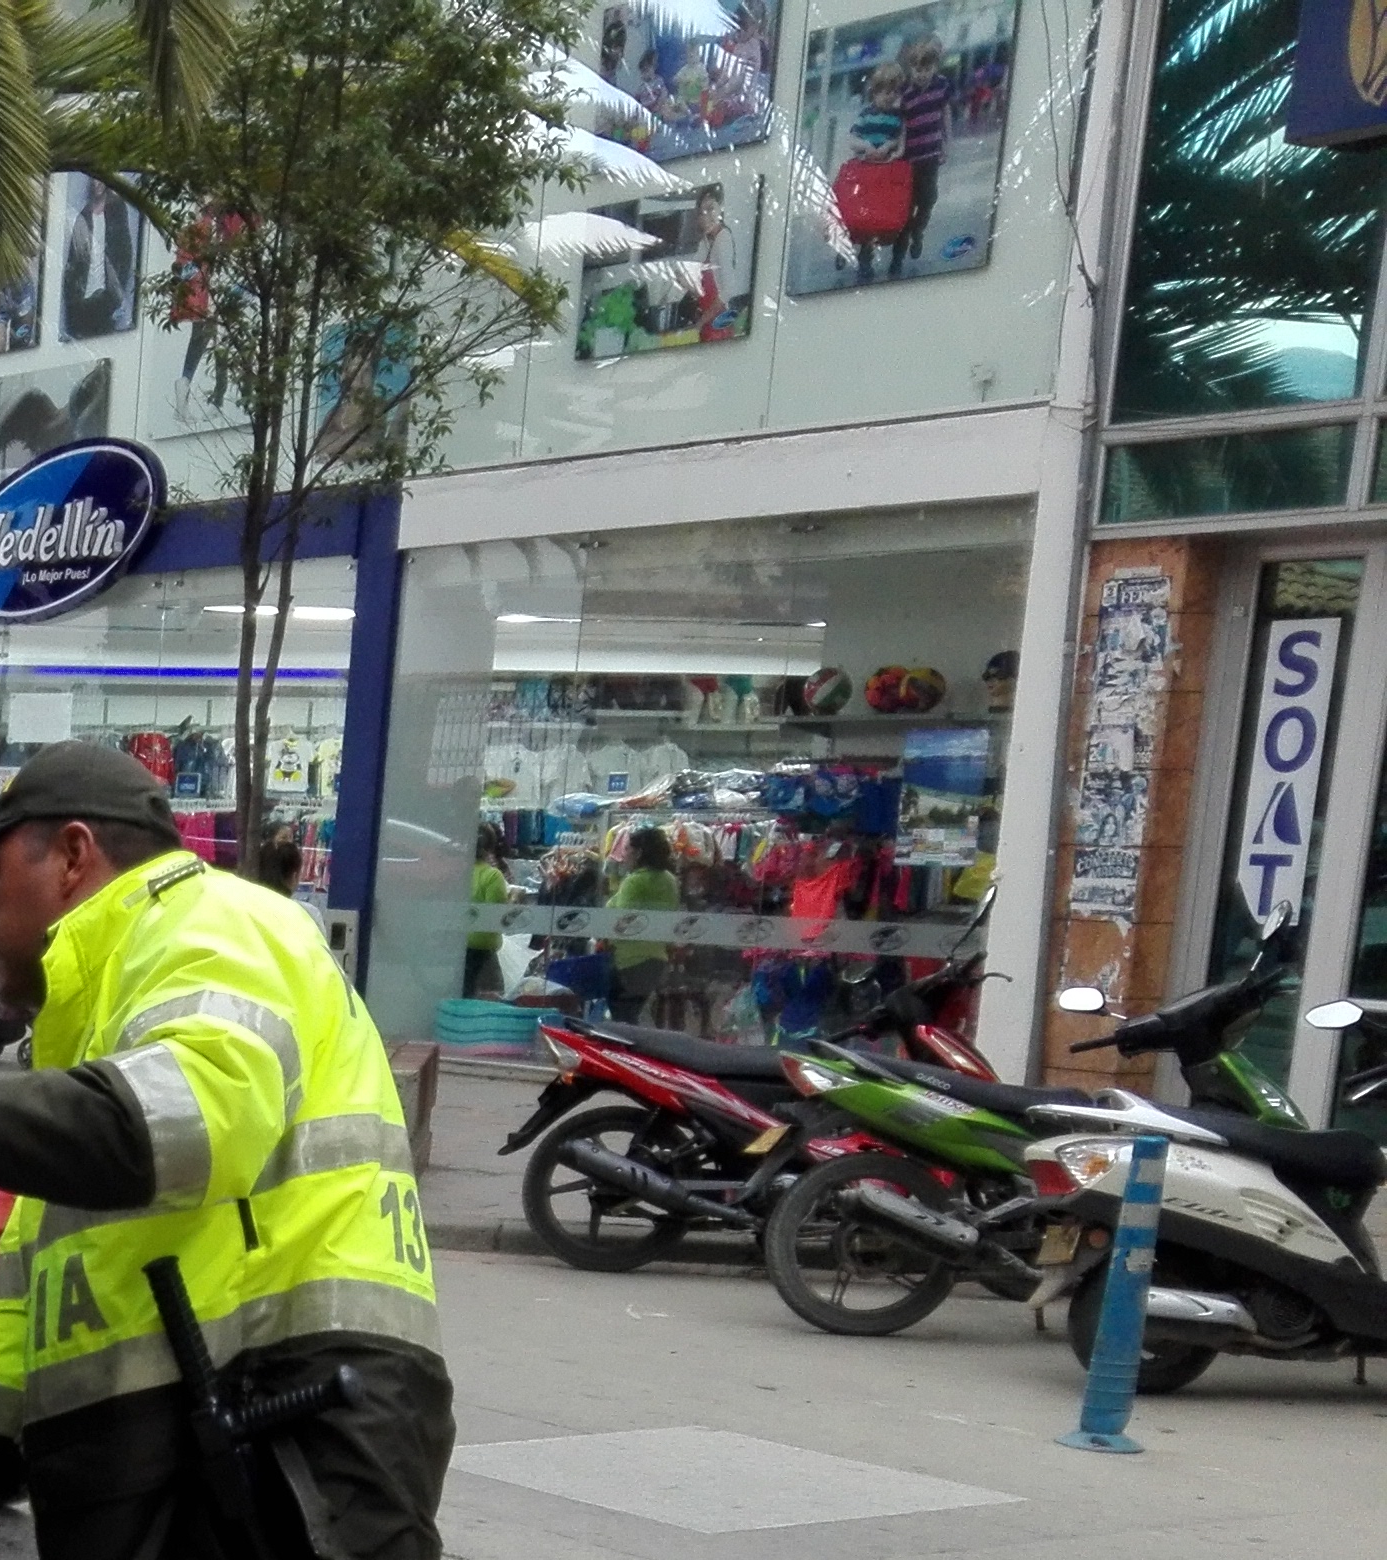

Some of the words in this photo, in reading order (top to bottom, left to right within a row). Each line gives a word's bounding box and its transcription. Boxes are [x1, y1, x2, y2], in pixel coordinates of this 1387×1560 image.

[39, 569, 63, 584] Mejor
[65, 567, 91, 580] Pues!
[1249, 630, 1322, 916] SOAT
[916, 1072, 952, 1091] auteco
